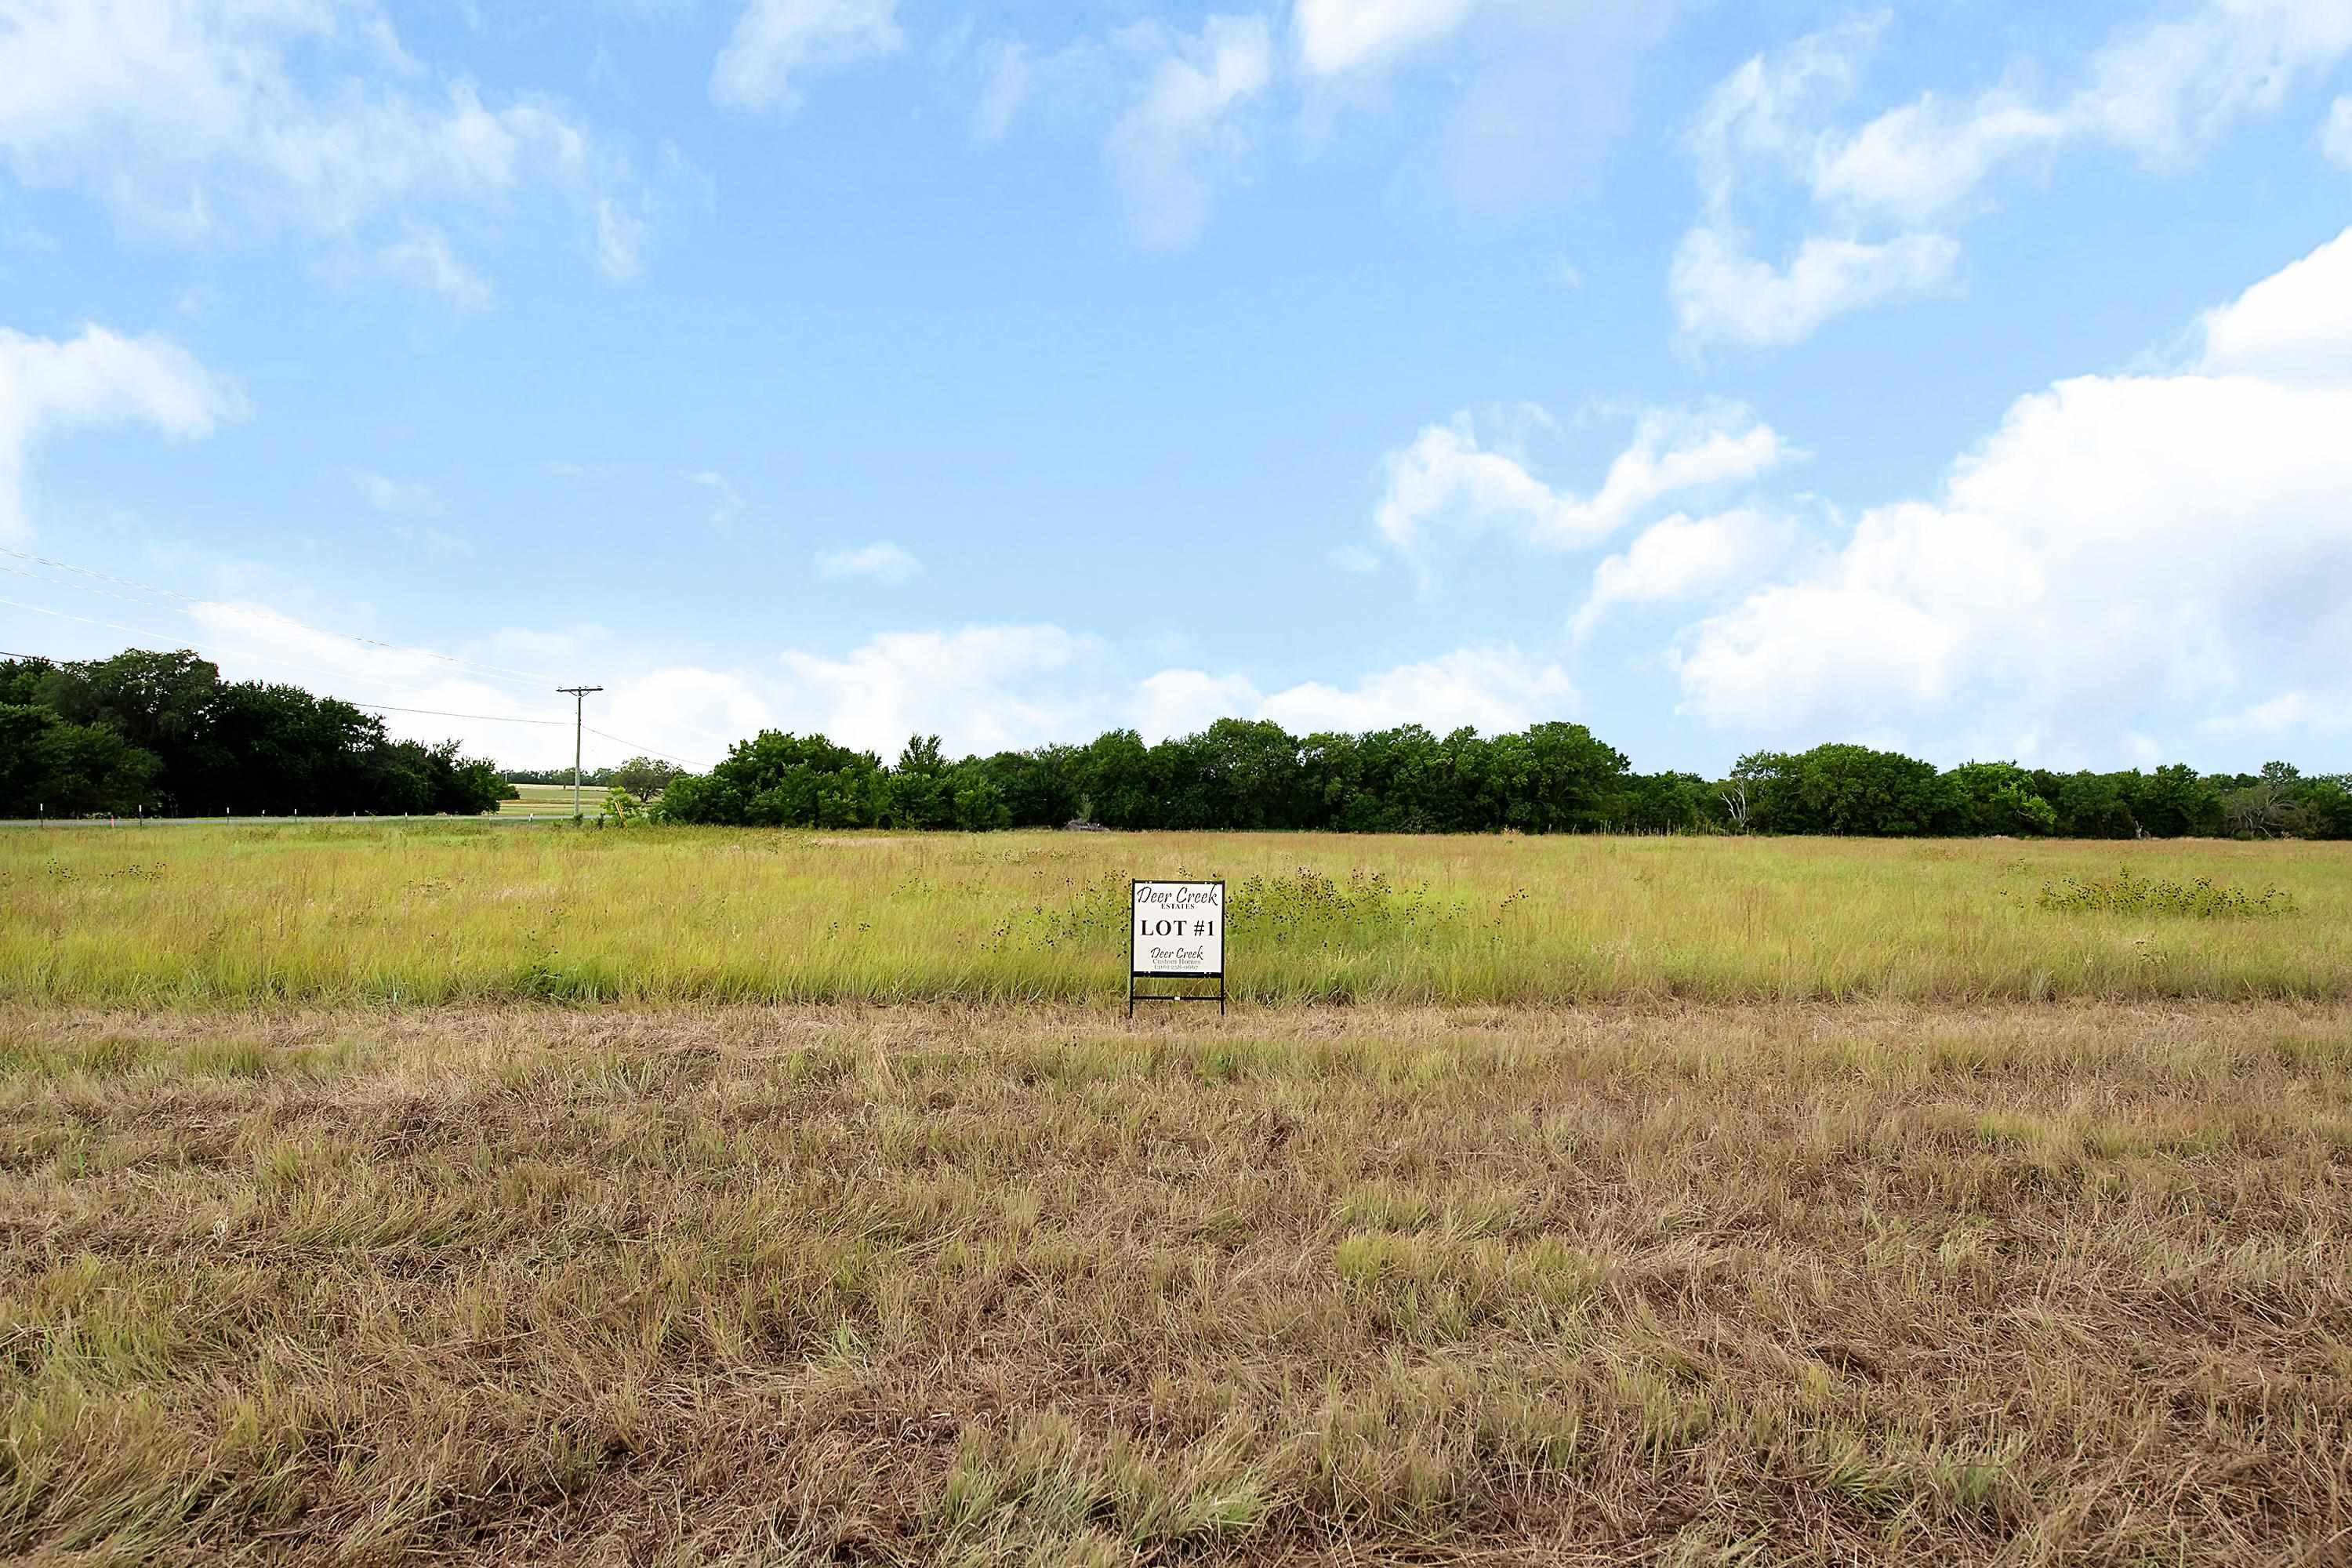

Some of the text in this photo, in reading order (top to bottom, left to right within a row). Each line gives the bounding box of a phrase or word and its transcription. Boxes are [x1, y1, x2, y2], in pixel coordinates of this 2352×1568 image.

[1137, 884, 1218, 906] Deer Creek
[1140, 920, 1214, 937] LOT #1
[1150, 946, 1203, 960] Deer Creek
